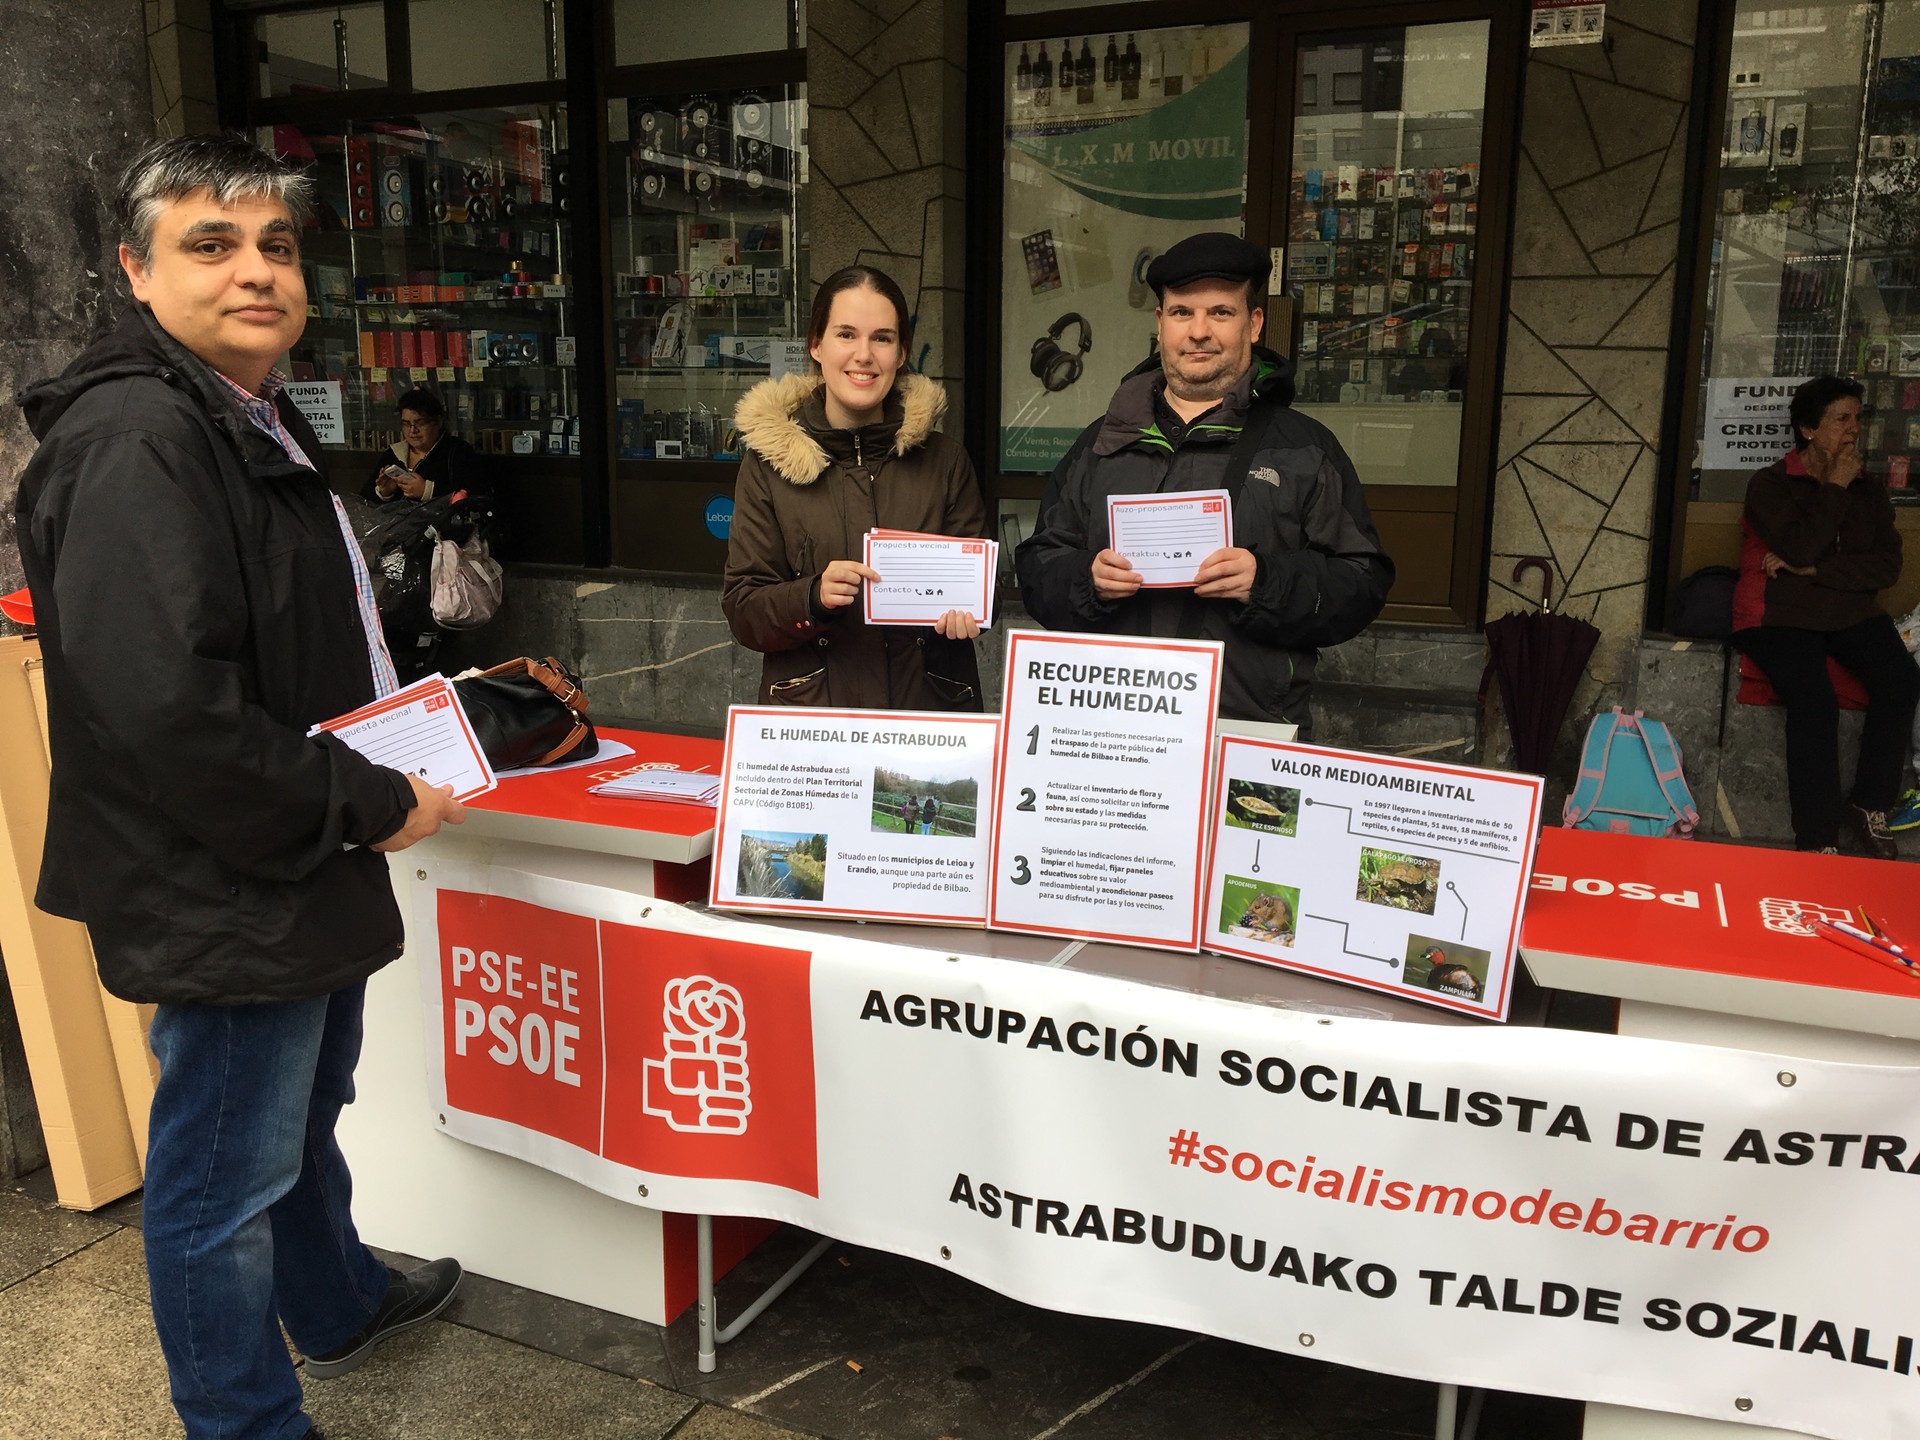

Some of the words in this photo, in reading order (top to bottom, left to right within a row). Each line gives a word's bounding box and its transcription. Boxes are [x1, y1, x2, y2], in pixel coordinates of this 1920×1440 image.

[1149, 136, 1236, 162] MOVIL
[288, 387, 327, 396] FUNDA
[1734, 386, 1798, 398] FUND
[302, 412, 334, 420] STAL
[1721, 424, 1792, 435] CRIST
[1006, 448, 1037, 457] Cambio
[1115, 504, 1194, 513] Auzo-proposamena
[873, 541, 917, 550] Propuesta
[1028, 661, 1196, 690] RECUPEREMOS
[1038, 686, 1062, 705] EL
[1070, 688, 1182, 714] HUMEDAL
[380, 706, 412, 724] vecinal
[761, 728, 776, 739] EL
[780, 728, 846, 742] HUMEDAL
[851, 731, 868, 743] DE
[872, 732, 966, 747] ASTRABUDUA
[1026, 724, 1039, 755] 1
[746, 762, 778, 770] humedal
[790, 764, 832, 773] Astrabudua
[824, 778, 862, 786] Territorial
[1047, 781, 1082, 790] Actualizar
[1091, 785, 1127, 794] inventario
[1271, 758, 1321, 777] VALOR
[1325, 766, 1474, 801] MEDIOAMBIENTAL
[805, 789, 839, 798] Húmedas
[1016, 787, 1036, 811] 2
[1046, 792, 1067, 801] fauna,
[1141, 801, 1169, 810] informe
[1392, 804, 1420, 814] llegaron
[1427, 810, 1473, 823] inventariarse
[1264, 824, 1293, 834] ESPINOSO
[1362, 811, 1390, 820] especies
[1402, 817, 1429, 827] plantas,
[1441, 824, 1458, 832] aves,
[1471, 829, 1510, 841] mamíferos,
[1361, 822, 1389, 831] reptiles,
[1396, 827, 1425, 836] especies
[1479, 841, 1509, 851] anfibios.
[838, 852, 865, 860] Situado
[891, 856, 933, 865] municipios
[946, 858, 967, 866] Leioa
[1041, 846, 1075, 856] Siguiendo
[1088, 851, 1132, 861] indicaciones
[1146, 857, 1175, 866] informe,
[847, 865, 878, 874] Erandio,
[1010, 855, 1031, 885] 3
[1040, 857, 1065, 866] limpiar
[1075, 861, 1107, 871] humedal,
[1109, 864, 1124, 873] fijar
[1040, 869, 1077, 878] educativos
[892, 882, 930, 890] propiedad
[944, 883, 970, 892] Bilbao.
[1039, 881, 1094, 891] medioambiental
[1101, 888, 1147, 897] acondicionar
[1228, 880, 1257, 890] APODEMUS
[1531, 873, 1700, 908] PSOE
[452, 946, 580, 1014] PSE-EE
[1440, 984, 1476, 999] ZAMPULLÍN
[454, 997, 580, 1088] PSOE
[860, 989, 1198, 1078] AGRUPACIÓN
[1218, 1049, 1592, 1142] SOCIALISTA
[1616, 1112, 1704, 1158] DE
[1169, 1128, 1770, 1254] #socialismodebarrio
[949, 1173, 1397, 1299] ASTRABUDUAKO
[1418, 1270, 1622, 1325] TALDE
[1643, 1298, 1920, 1376] SOZIALI
